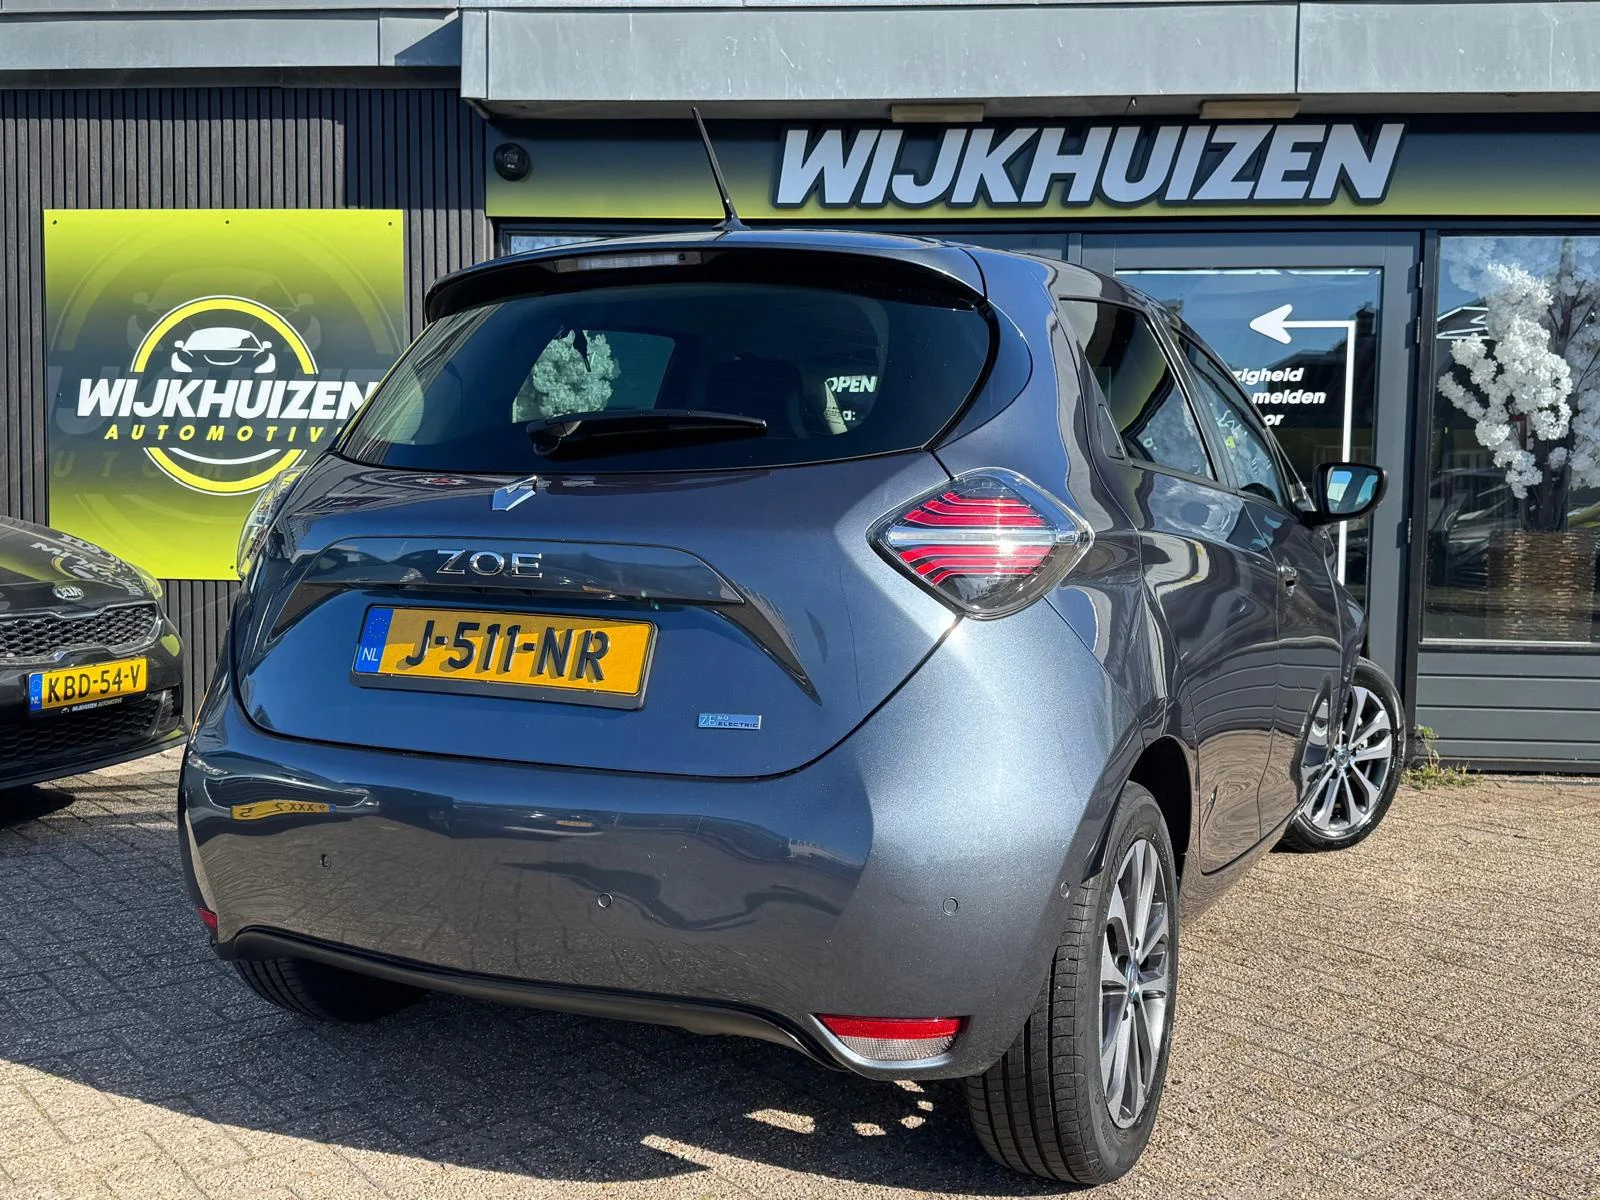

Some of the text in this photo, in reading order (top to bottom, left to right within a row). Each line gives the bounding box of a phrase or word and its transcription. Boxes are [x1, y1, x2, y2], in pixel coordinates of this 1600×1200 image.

[776, 123, 1405, 205] WIJKHUIZEN
[77, 378, 381, 420] WIJKHUIZEN
[825, 375, 878, 393] OPEN
[1252, 389, 1327, 405] melden
[436, 549, 543, 578] ZOE
[361, 647, 379, 662] NL
[405, 620, 612, 681] J-511-NR
[47, 664, 141, 704] KBD-54-V
